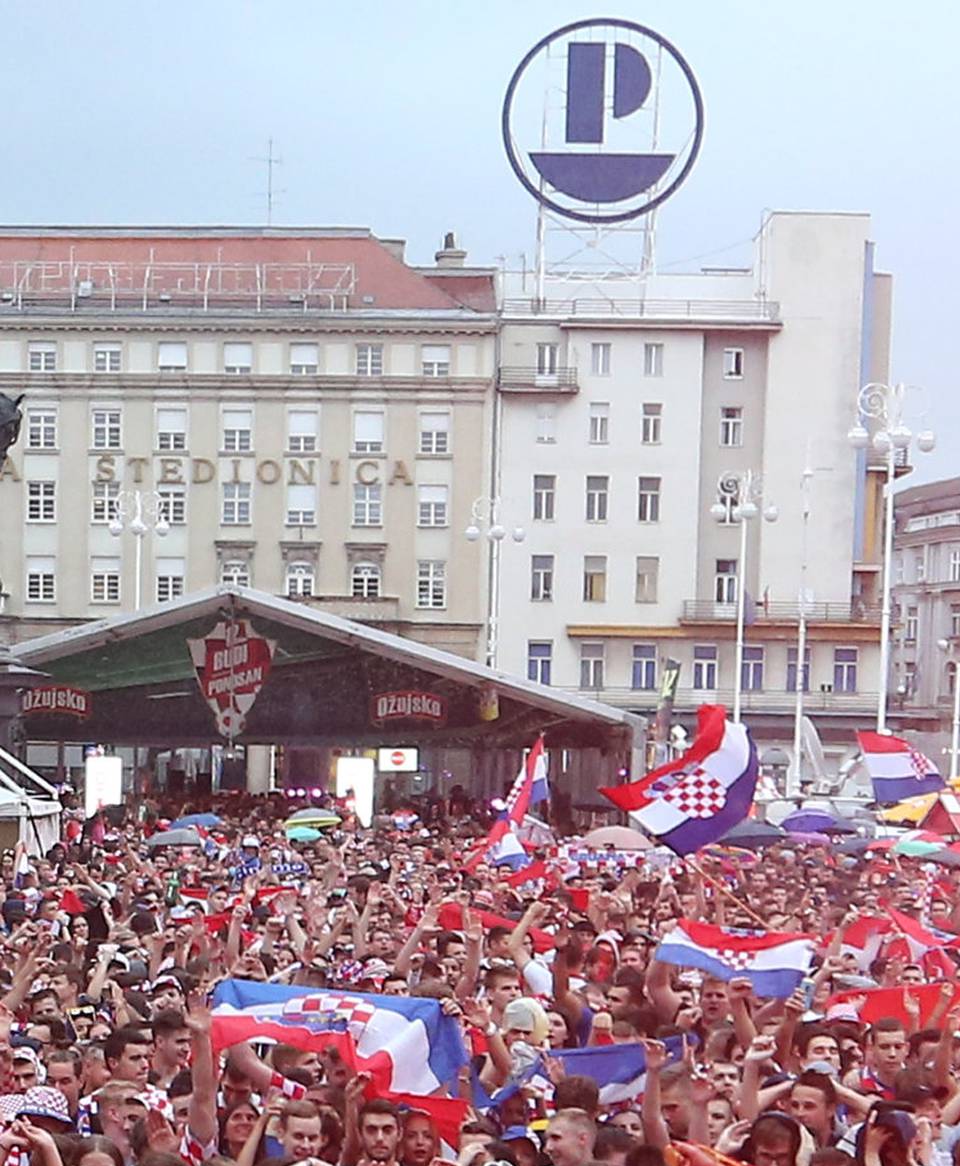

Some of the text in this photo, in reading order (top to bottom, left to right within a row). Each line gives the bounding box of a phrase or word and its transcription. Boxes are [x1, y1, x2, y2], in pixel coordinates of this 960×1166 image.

[96, 453, 415, 487] ŠTEDIONICA
[213, 643, 248, 672] BUDI
[207, 665, 262, 696] PONOSAN
[377, 693, 441, 717] Ožujsko
